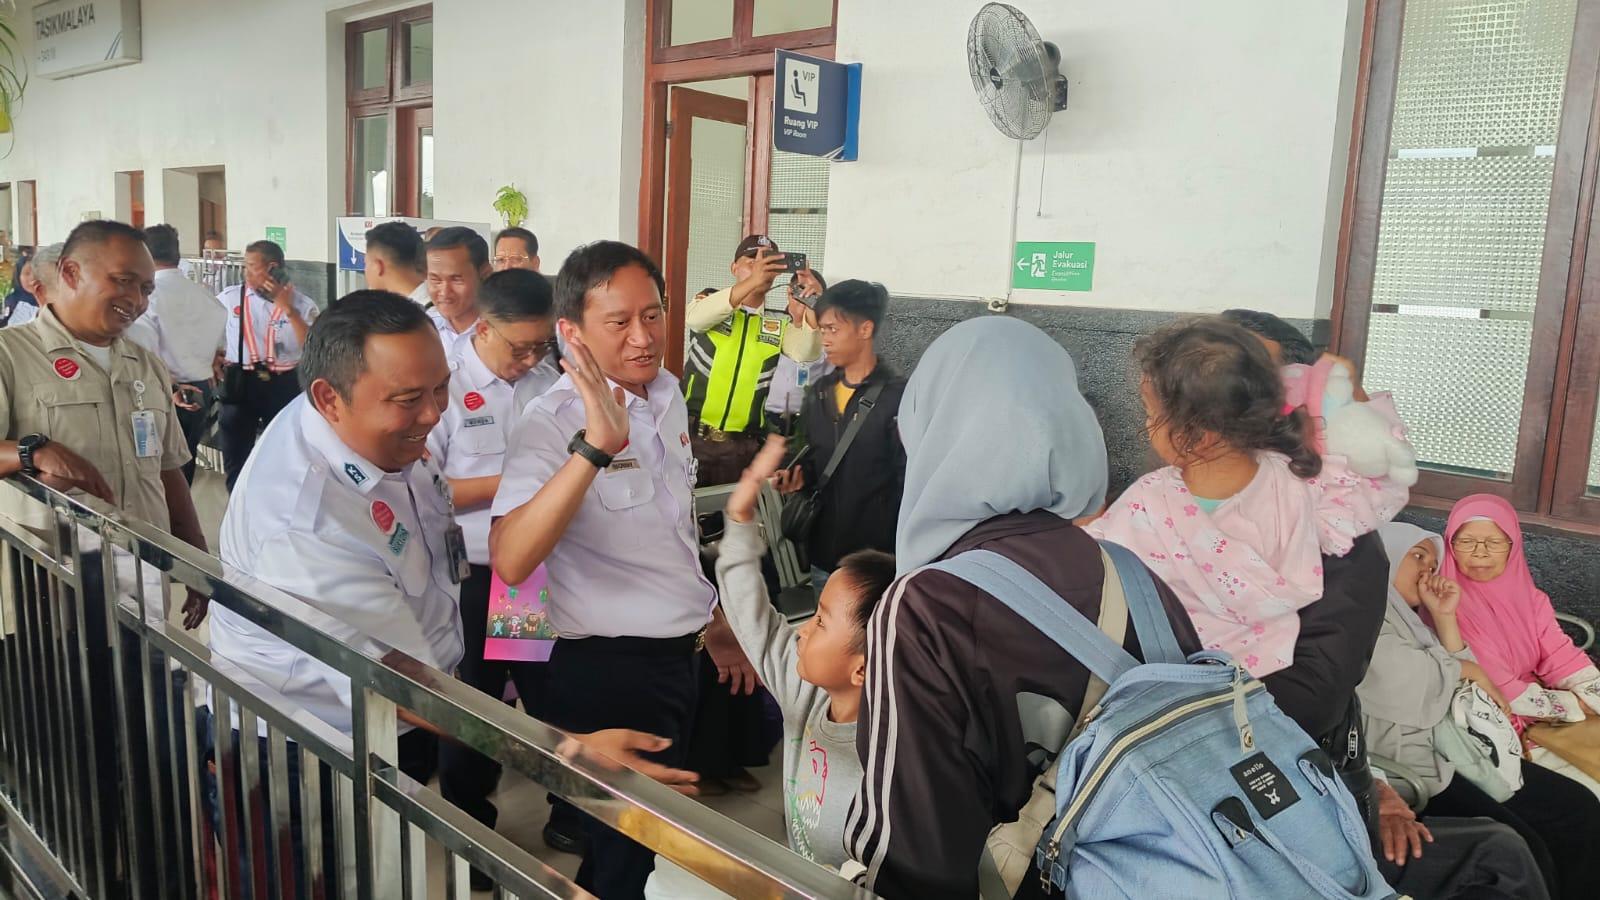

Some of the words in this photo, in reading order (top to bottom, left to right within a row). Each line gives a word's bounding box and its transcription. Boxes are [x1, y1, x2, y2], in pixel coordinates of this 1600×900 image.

[35, 3, 96, 40] TASIKMALAYA
[802, 71, 816, 82] VIP
[784, 116, 806, 130] Ruang
[806, 119, 819, 130] VIP
[783, 128, 793, 136] VIP
[793, 129, 807, 139] Room
[1052, 251, 1074, 259] Jalur
[1052, 260, 1088, 269] Evakuasi
